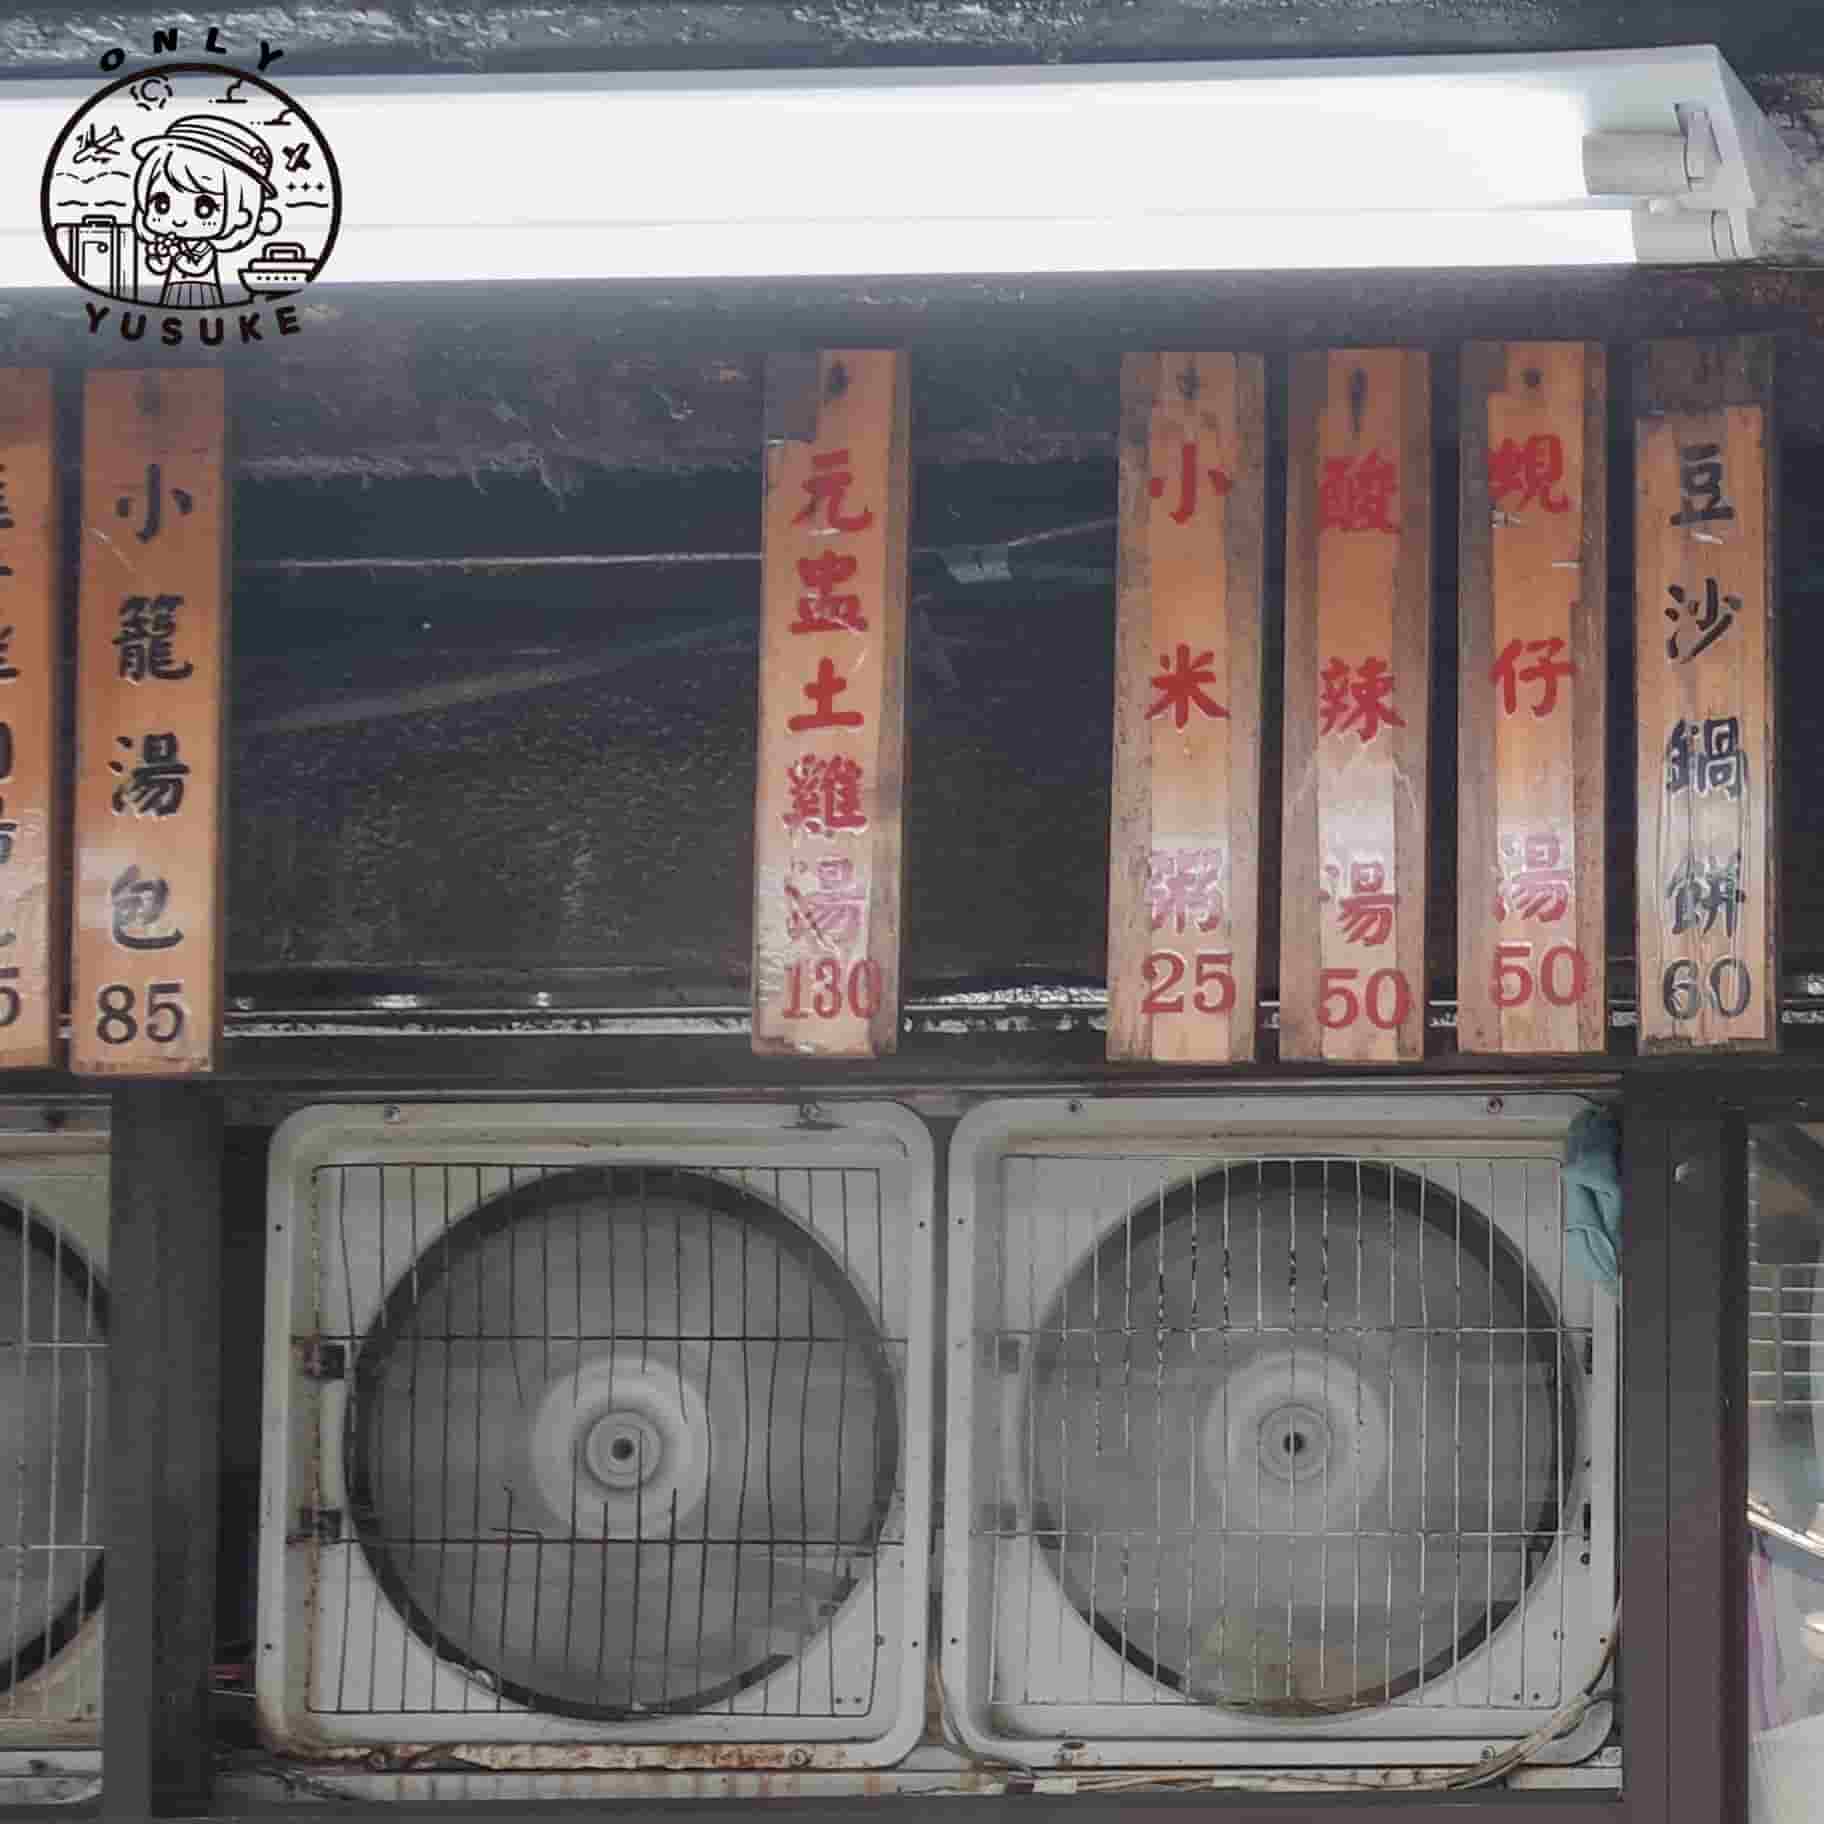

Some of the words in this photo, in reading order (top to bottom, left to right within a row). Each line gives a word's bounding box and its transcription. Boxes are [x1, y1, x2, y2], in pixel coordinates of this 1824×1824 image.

[109, 463, 194, 951] 小籠湯包
[1144, 443, 1231, 934] 小米粥
[1317, 454, 1406, 946] 酸辣湯
[1488, 433, 1579, 925] 蜆仔湯
[1664, 444, 1747, 935] 豆沙鍋餅
[780, 957, 884, 1021] 130
[1140, 952, 1236, 1015] 25
[1316, 968, 1410, 1029] 50
[1489, 945, 1587, 1008] 50
[1663, 958, 1751, 1021] 60
[95, 983, 185, 1045] 85
